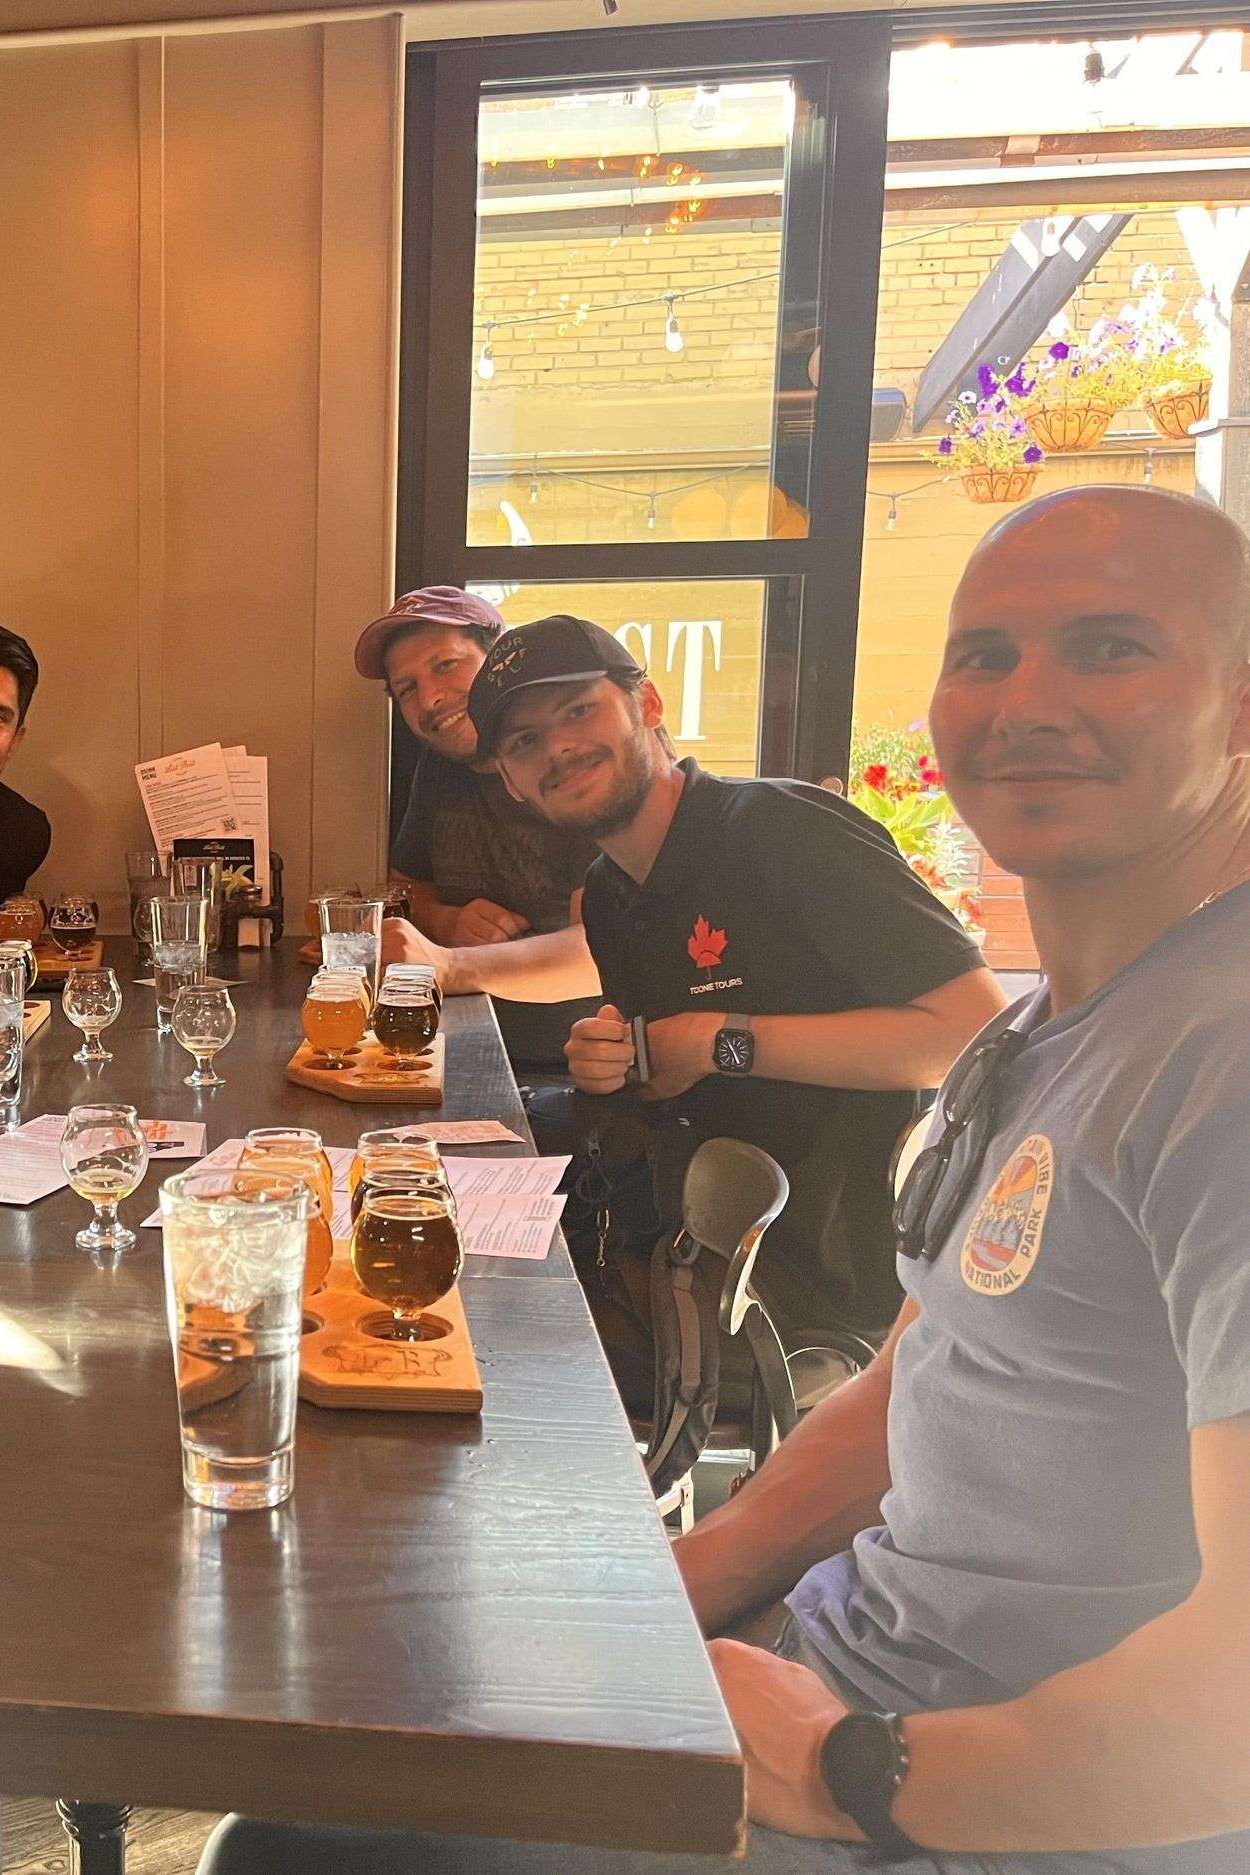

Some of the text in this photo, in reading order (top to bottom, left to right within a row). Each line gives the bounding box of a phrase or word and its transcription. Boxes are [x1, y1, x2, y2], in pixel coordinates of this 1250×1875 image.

[489, 637, 523, 667] YOUR
[690, 978, 743, 995] TOONIE TOURS
[964, 1260, 1022, 1290] NATIONAL
[1020, 1209, 1042, 1258] PARK
